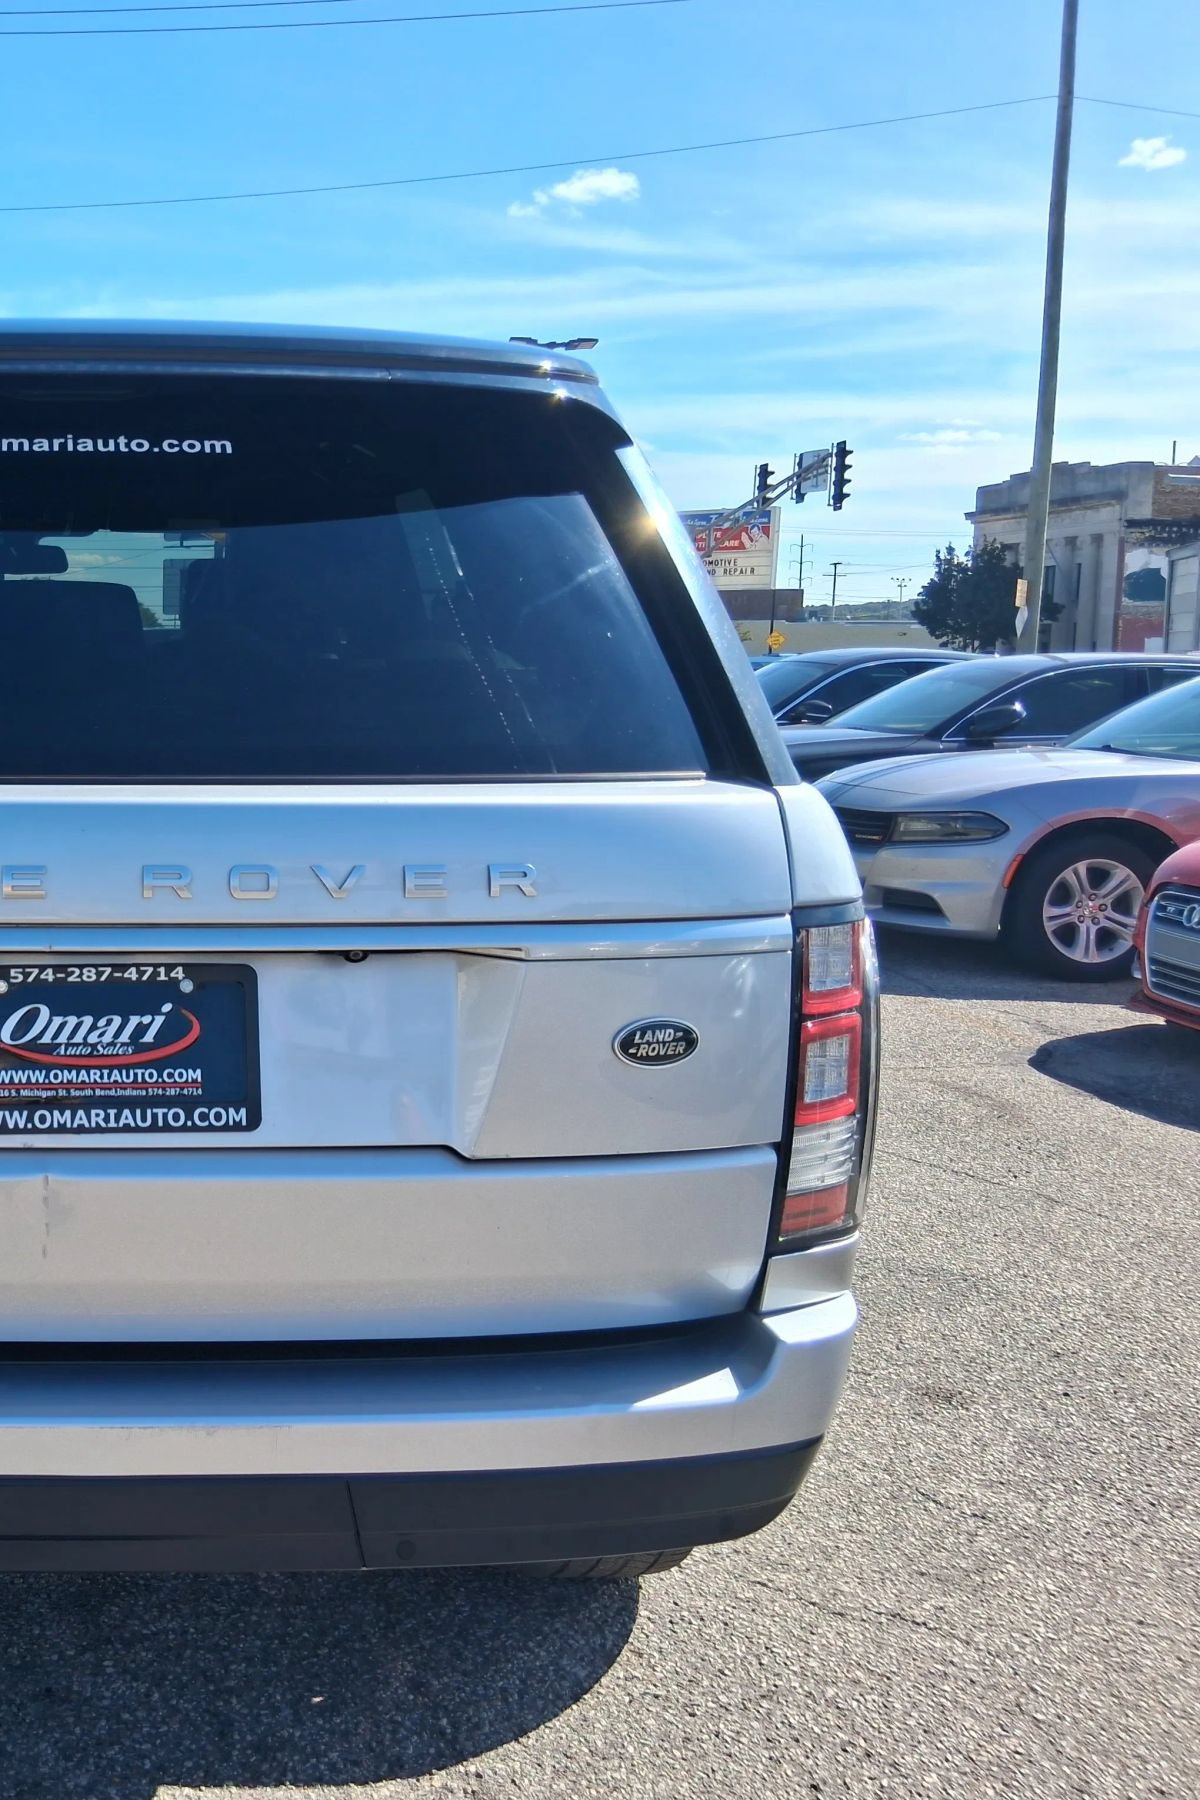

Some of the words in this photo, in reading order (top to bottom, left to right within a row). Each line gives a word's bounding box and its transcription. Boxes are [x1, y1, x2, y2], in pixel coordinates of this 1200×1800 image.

[723, 567, 755, 576] REPAIR
[142, 864, 538, 899] ROVER
[9, 966, 185, 983] 574-287-4714
[0, 1002, 173, 1045] Omari
[53, 1043, 91, 1056] Auto
[93, 1043, 135, 1056] Sales
[637, 1042, 686, 1057] ROVER
[11, 1089, 19, 1097] S.
[20, 1088, 57, 1098] Michigan
[58, 1088, 69, 1097] St.
[70, 1088, 93, 1097] South
[148, 1087, 202, 1096] 574-287-4714
